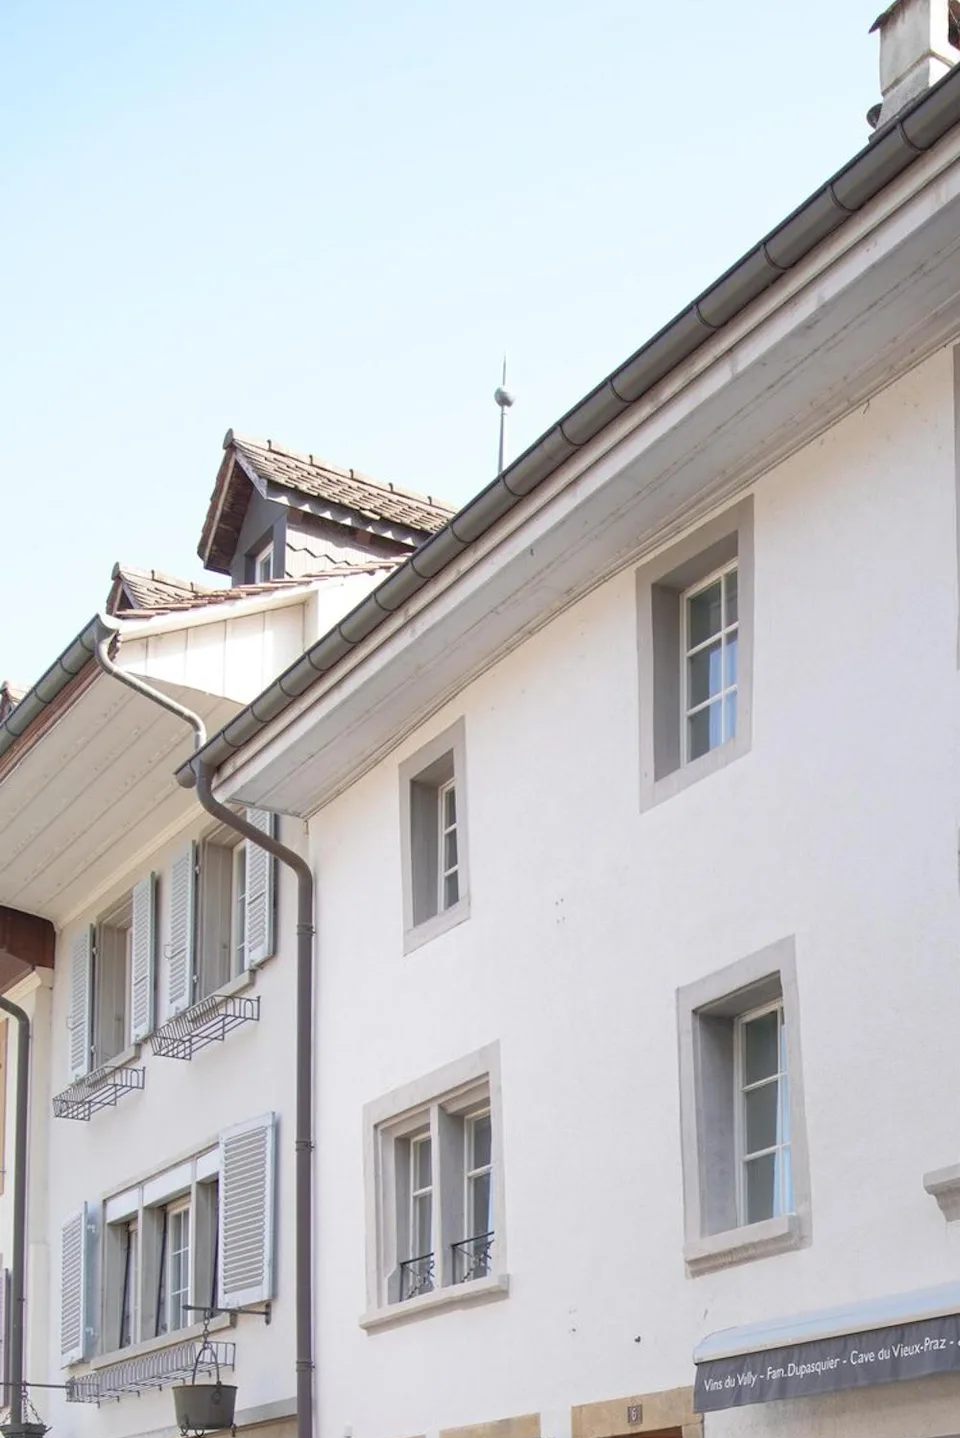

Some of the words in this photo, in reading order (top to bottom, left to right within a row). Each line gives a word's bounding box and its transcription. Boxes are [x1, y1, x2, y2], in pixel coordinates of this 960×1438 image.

[703, 1377, 723, 1392] Vins
[724, 1375, 736, 1389] du
[850, 1349, 875, 1366] Cave
[877, 1345, 891, 1360] du
